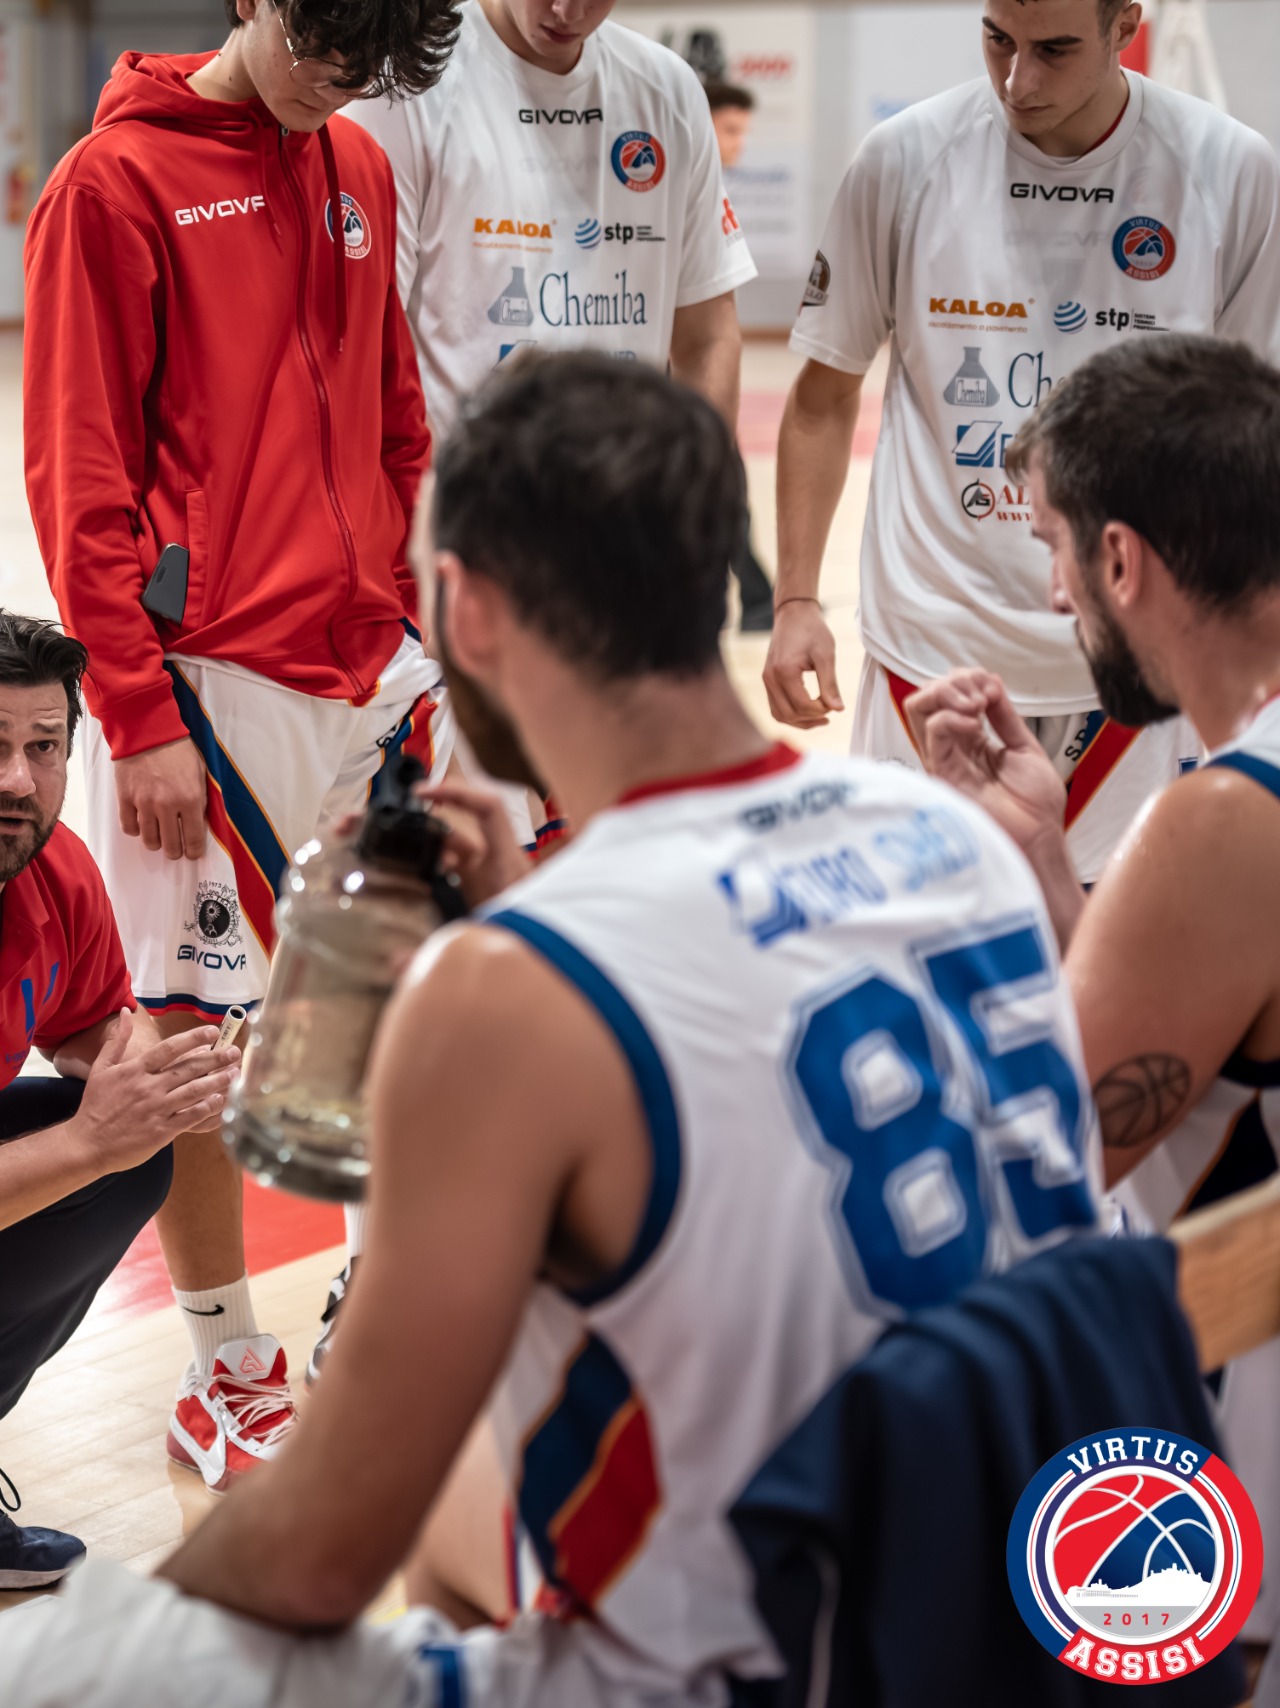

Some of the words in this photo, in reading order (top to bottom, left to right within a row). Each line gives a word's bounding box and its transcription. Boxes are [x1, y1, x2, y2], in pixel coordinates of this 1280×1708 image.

[519, 108, 604, 125] GIVOVA
[1010, 182, 1115, 204] GIVOVA
[604, 223, 634, 244] stp
[1128, 217, 1161, 231] VIRTUS
[1125, 266, 1161, 281] ASSISI
[539, 269, 648, 328] Chemiba
[929, 297, 1028, 319] KALOA
[1094, 308, 1130, 332] stp
[777, 912, 1098, 1318] 85
